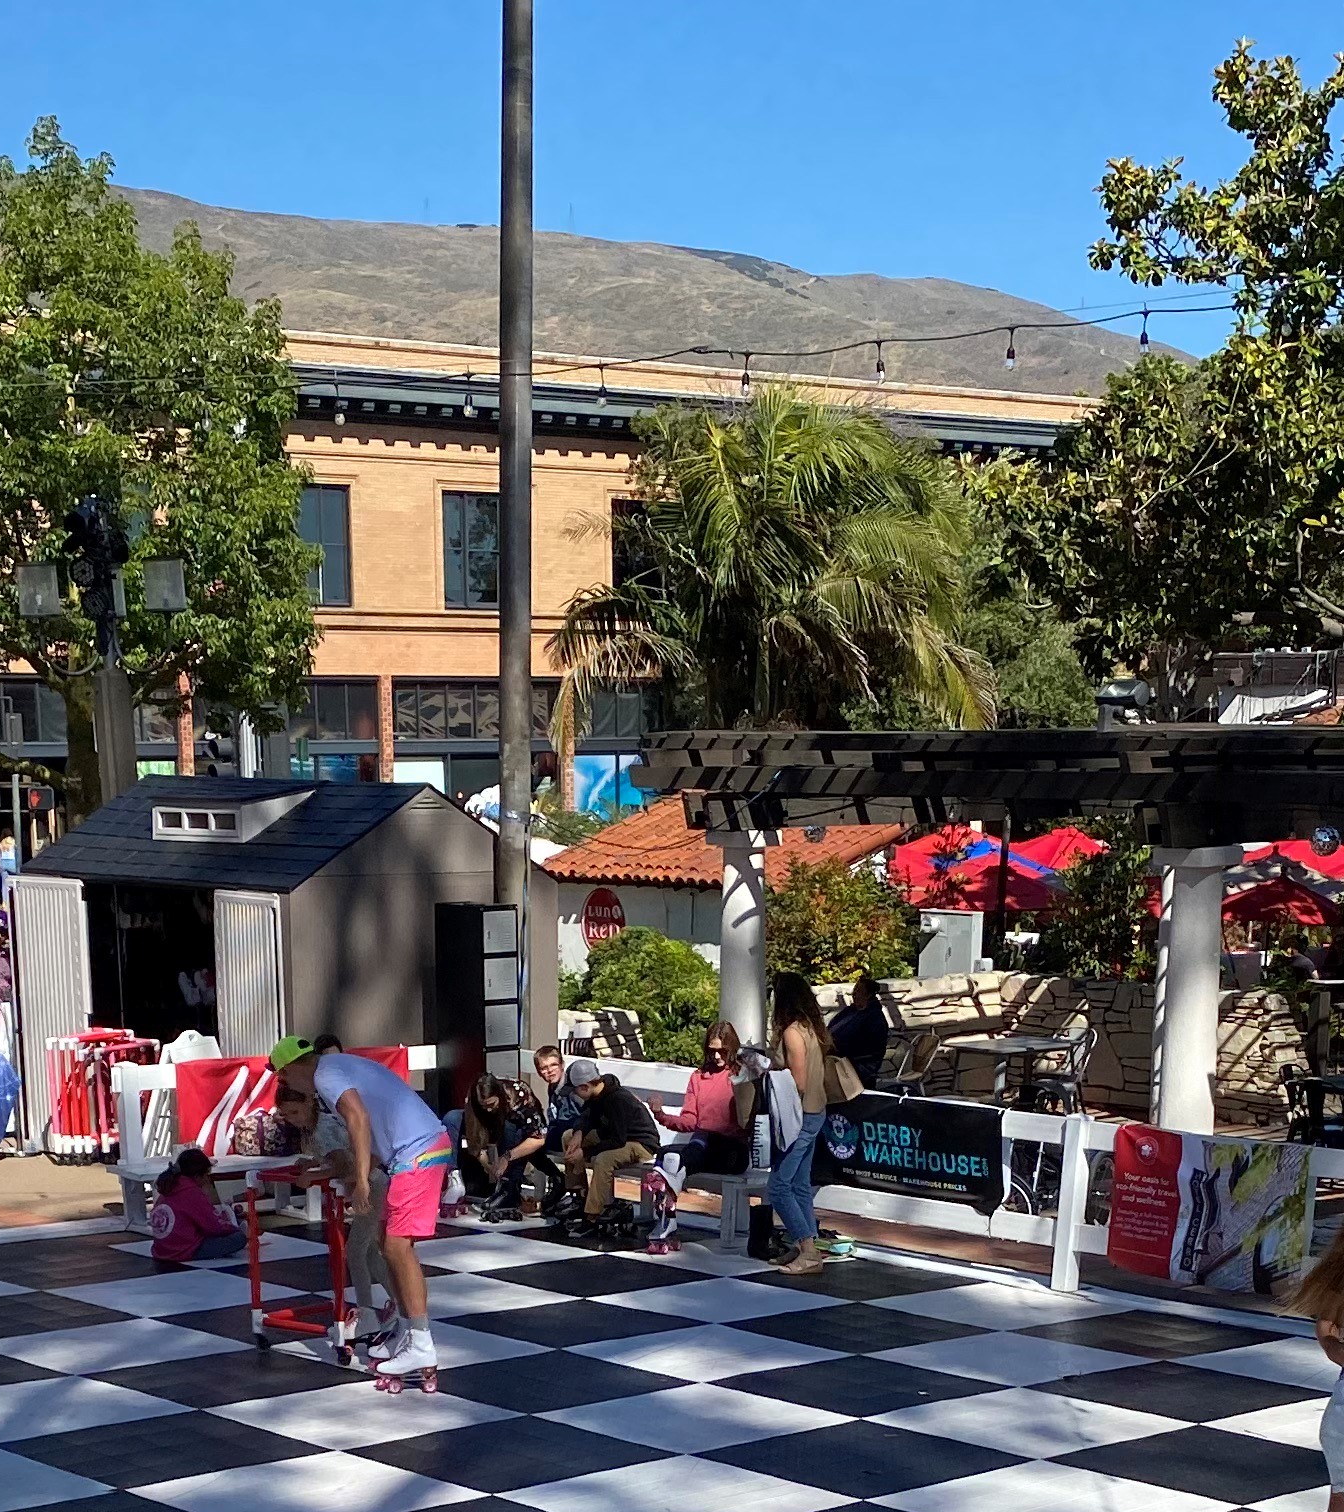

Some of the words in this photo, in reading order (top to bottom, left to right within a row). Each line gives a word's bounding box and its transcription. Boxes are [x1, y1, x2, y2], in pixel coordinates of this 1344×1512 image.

[862, 1121, 922, 1147] DERBY
[862, 1141, 982, 1177] WAREHOUSE
[902, 1177, 942, 1188] WAREHOUSE
[943, 1183, 967, 1191] PRICES
[1124, 1172, 1141, 1183] Your
[1160, 1177, 1169, 1186] for
[1116, 1182, 1157, 1196] eco-friendly
[1158, 1188, 1178, 1198] travel
[1122, 1194, 1135, 1202] and
